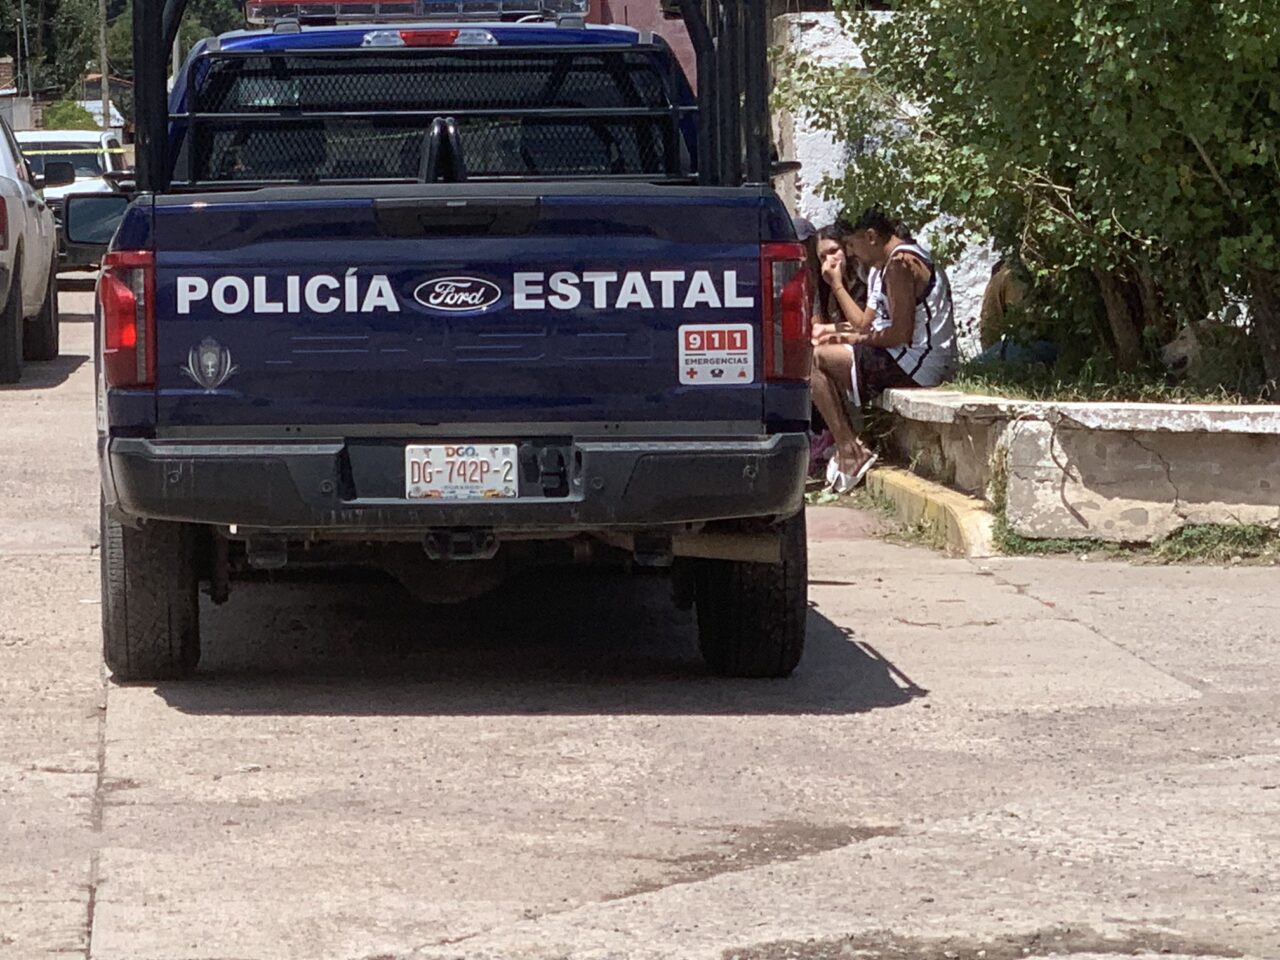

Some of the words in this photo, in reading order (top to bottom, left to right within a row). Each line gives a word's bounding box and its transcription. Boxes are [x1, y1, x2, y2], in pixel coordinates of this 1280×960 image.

[177, 267, 401, 315] POLICÍA
[513, 270, 755, 310] ESTATAL
[428, 280, 486, 306] Ford
[688, 332, 742, 350] 911
[684, 357, 749, 366] EMERGENCIAS
[410, 460, 514, 485] DG-742P-2
